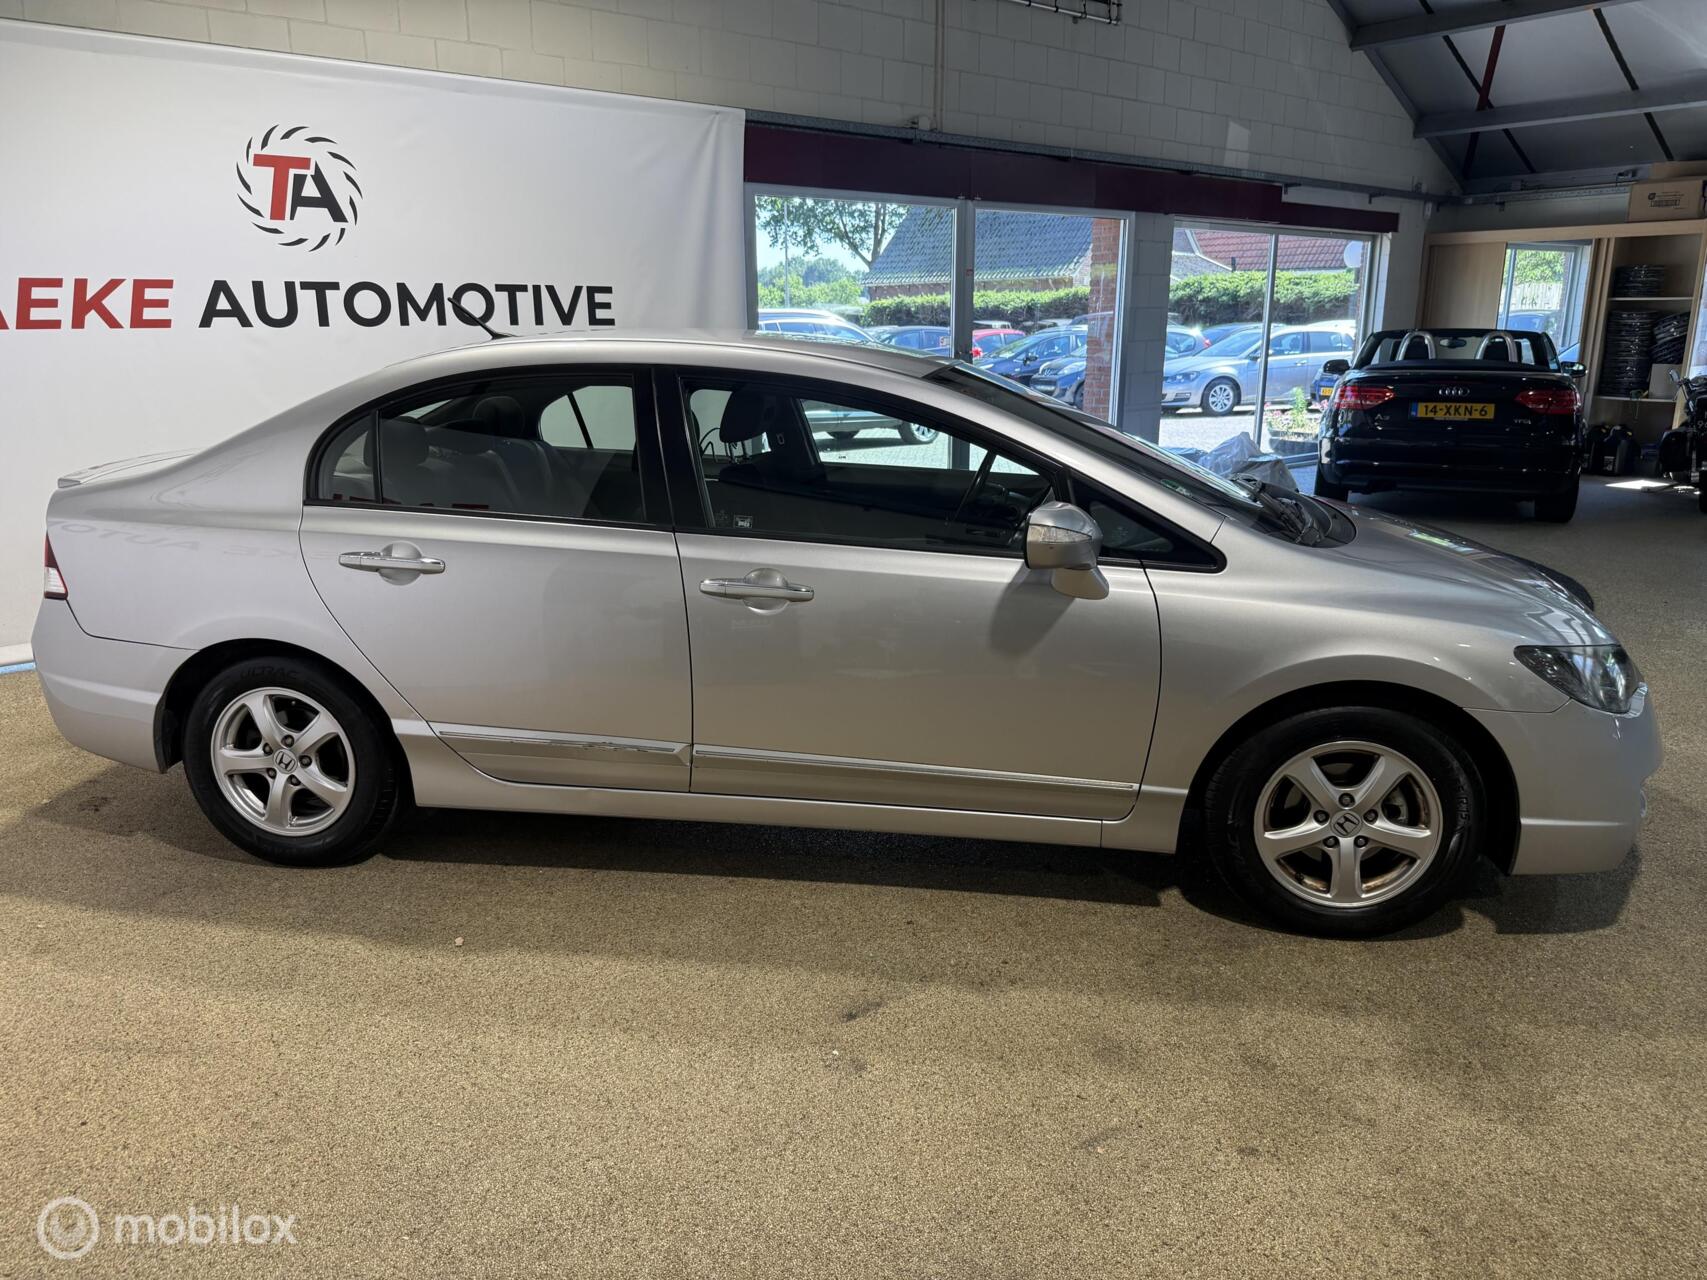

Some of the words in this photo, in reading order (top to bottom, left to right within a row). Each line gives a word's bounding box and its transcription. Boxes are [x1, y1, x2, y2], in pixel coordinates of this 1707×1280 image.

[253, 154, 348, 223] TA
[0, 277, 174, 330] EKE
[199, 280, 615, 328] AUTOMOTIVE
[1424, 404, 1488, 416] 14-XKN-6
